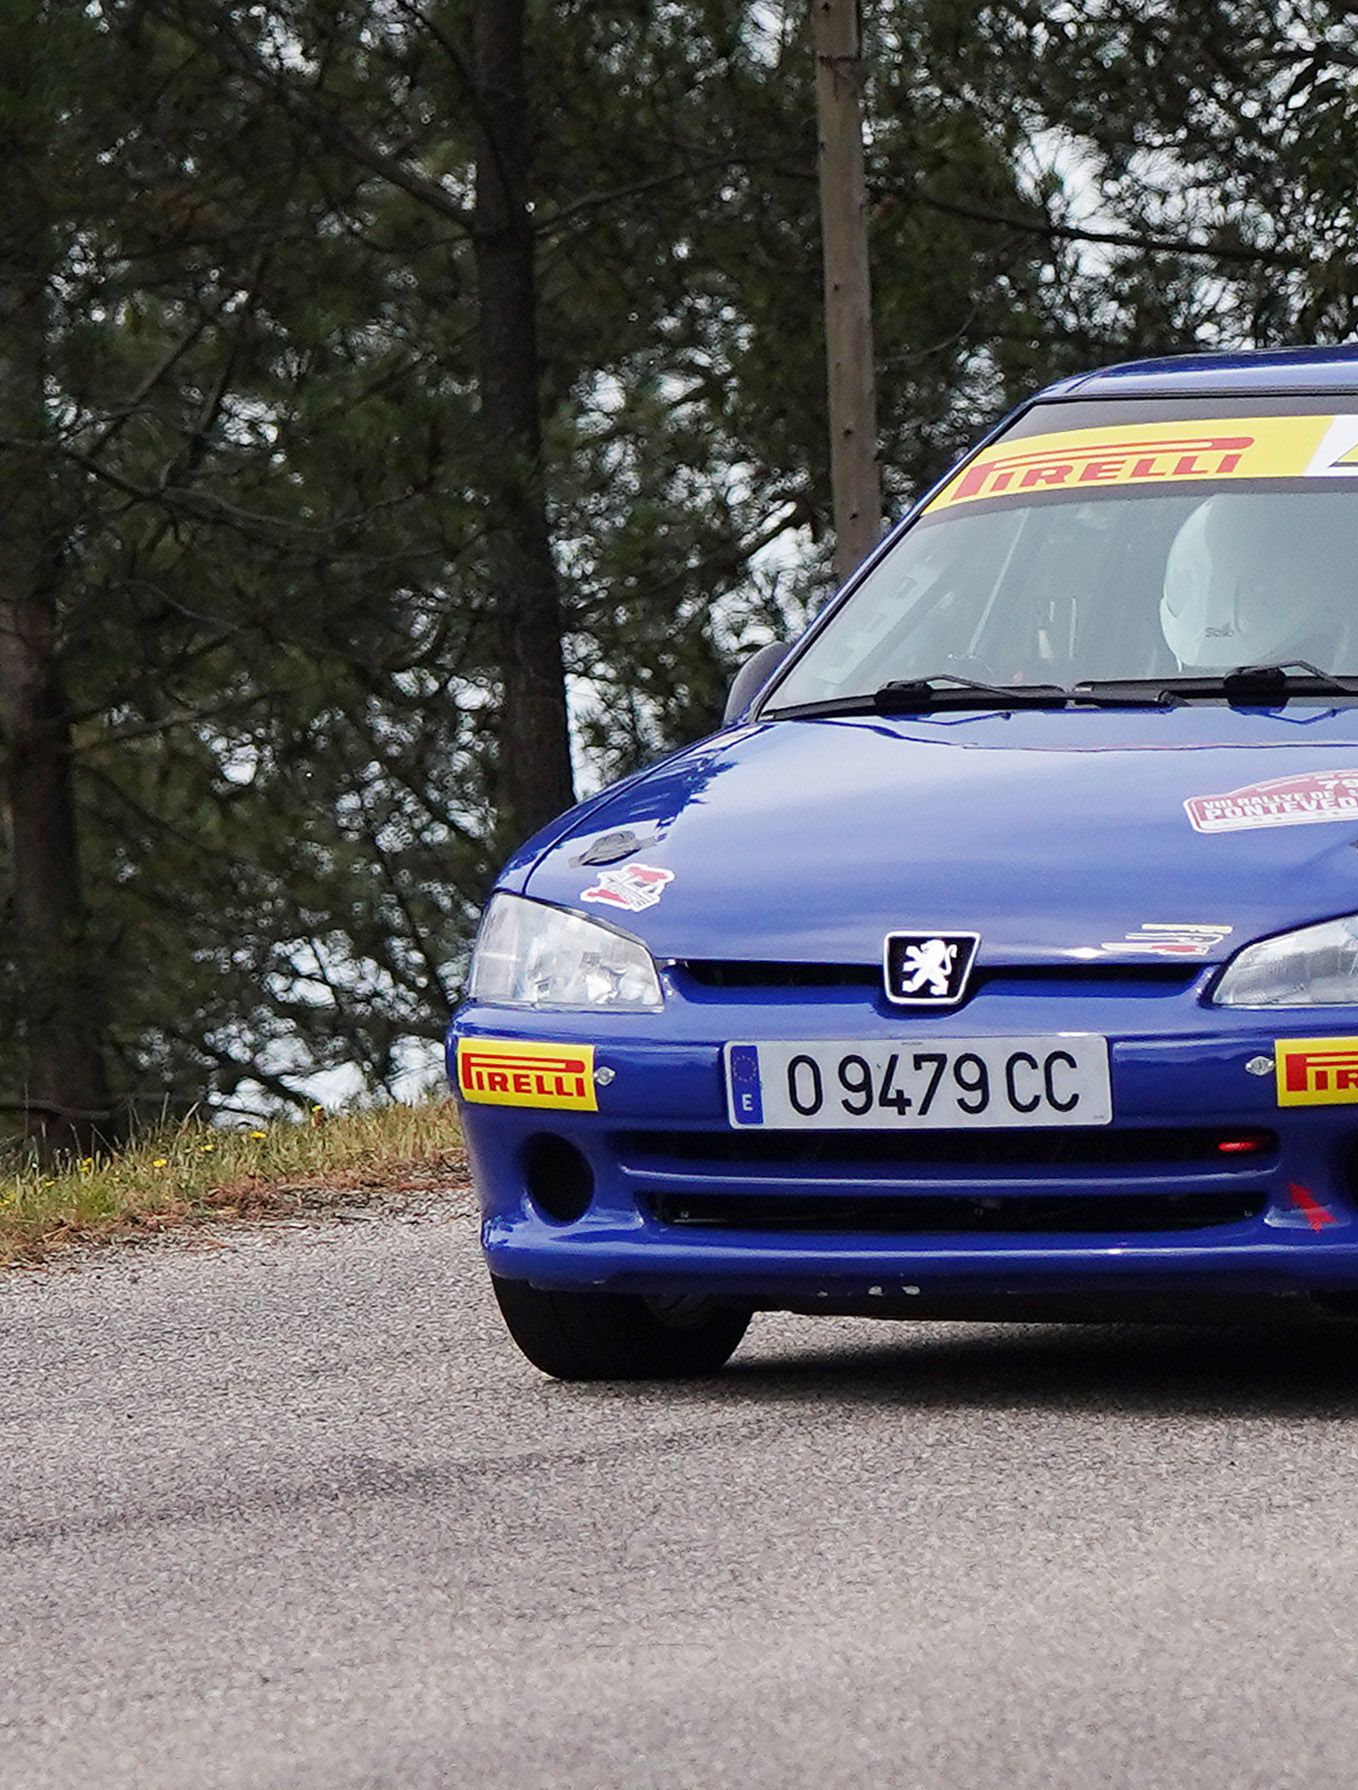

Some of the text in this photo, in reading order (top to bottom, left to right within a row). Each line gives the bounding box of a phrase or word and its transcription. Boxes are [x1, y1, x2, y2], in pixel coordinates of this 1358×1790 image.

[950, 437, 1255, 501] PIRELLI
[1238, 792, 1306, 807] RALLYE
[1310, 790, 1335, 801] DE
[462, 1053, 586, 1097] PIRELLI
[838, 1052, 990, 1116] 9479
[1005, 1051, 1080, 1113] CC
[742, 1094, 753, 1111] E
